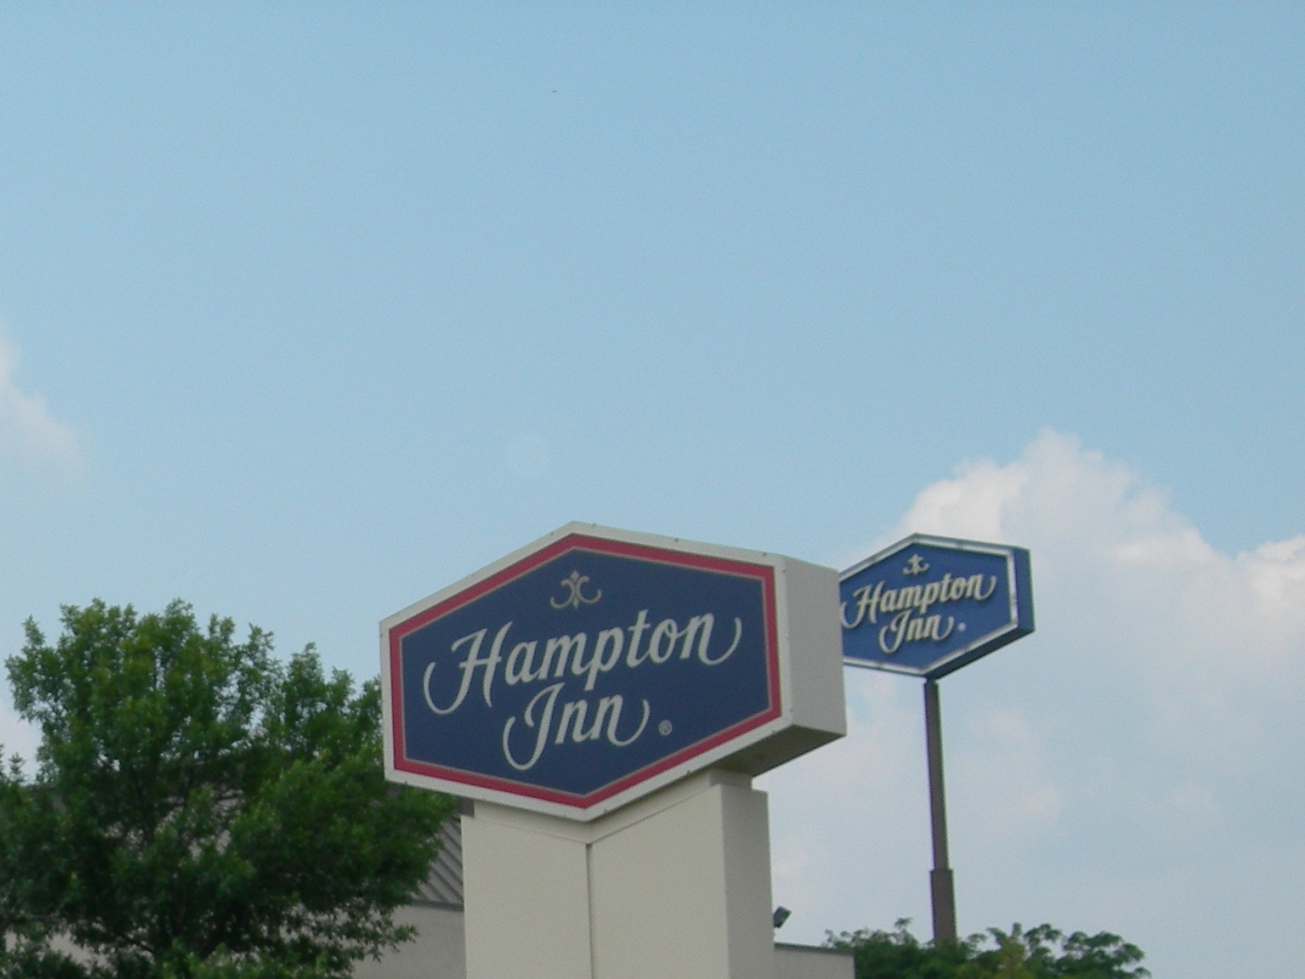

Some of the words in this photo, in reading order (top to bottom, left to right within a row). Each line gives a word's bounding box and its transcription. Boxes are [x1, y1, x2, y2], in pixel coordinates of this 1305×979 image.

[841, 572, 997, 629] Hampton
[878, 609, 955, 655] Inn
[422, 609, 742, 715] Hampton
[502, 682, 651, 771] Inn
